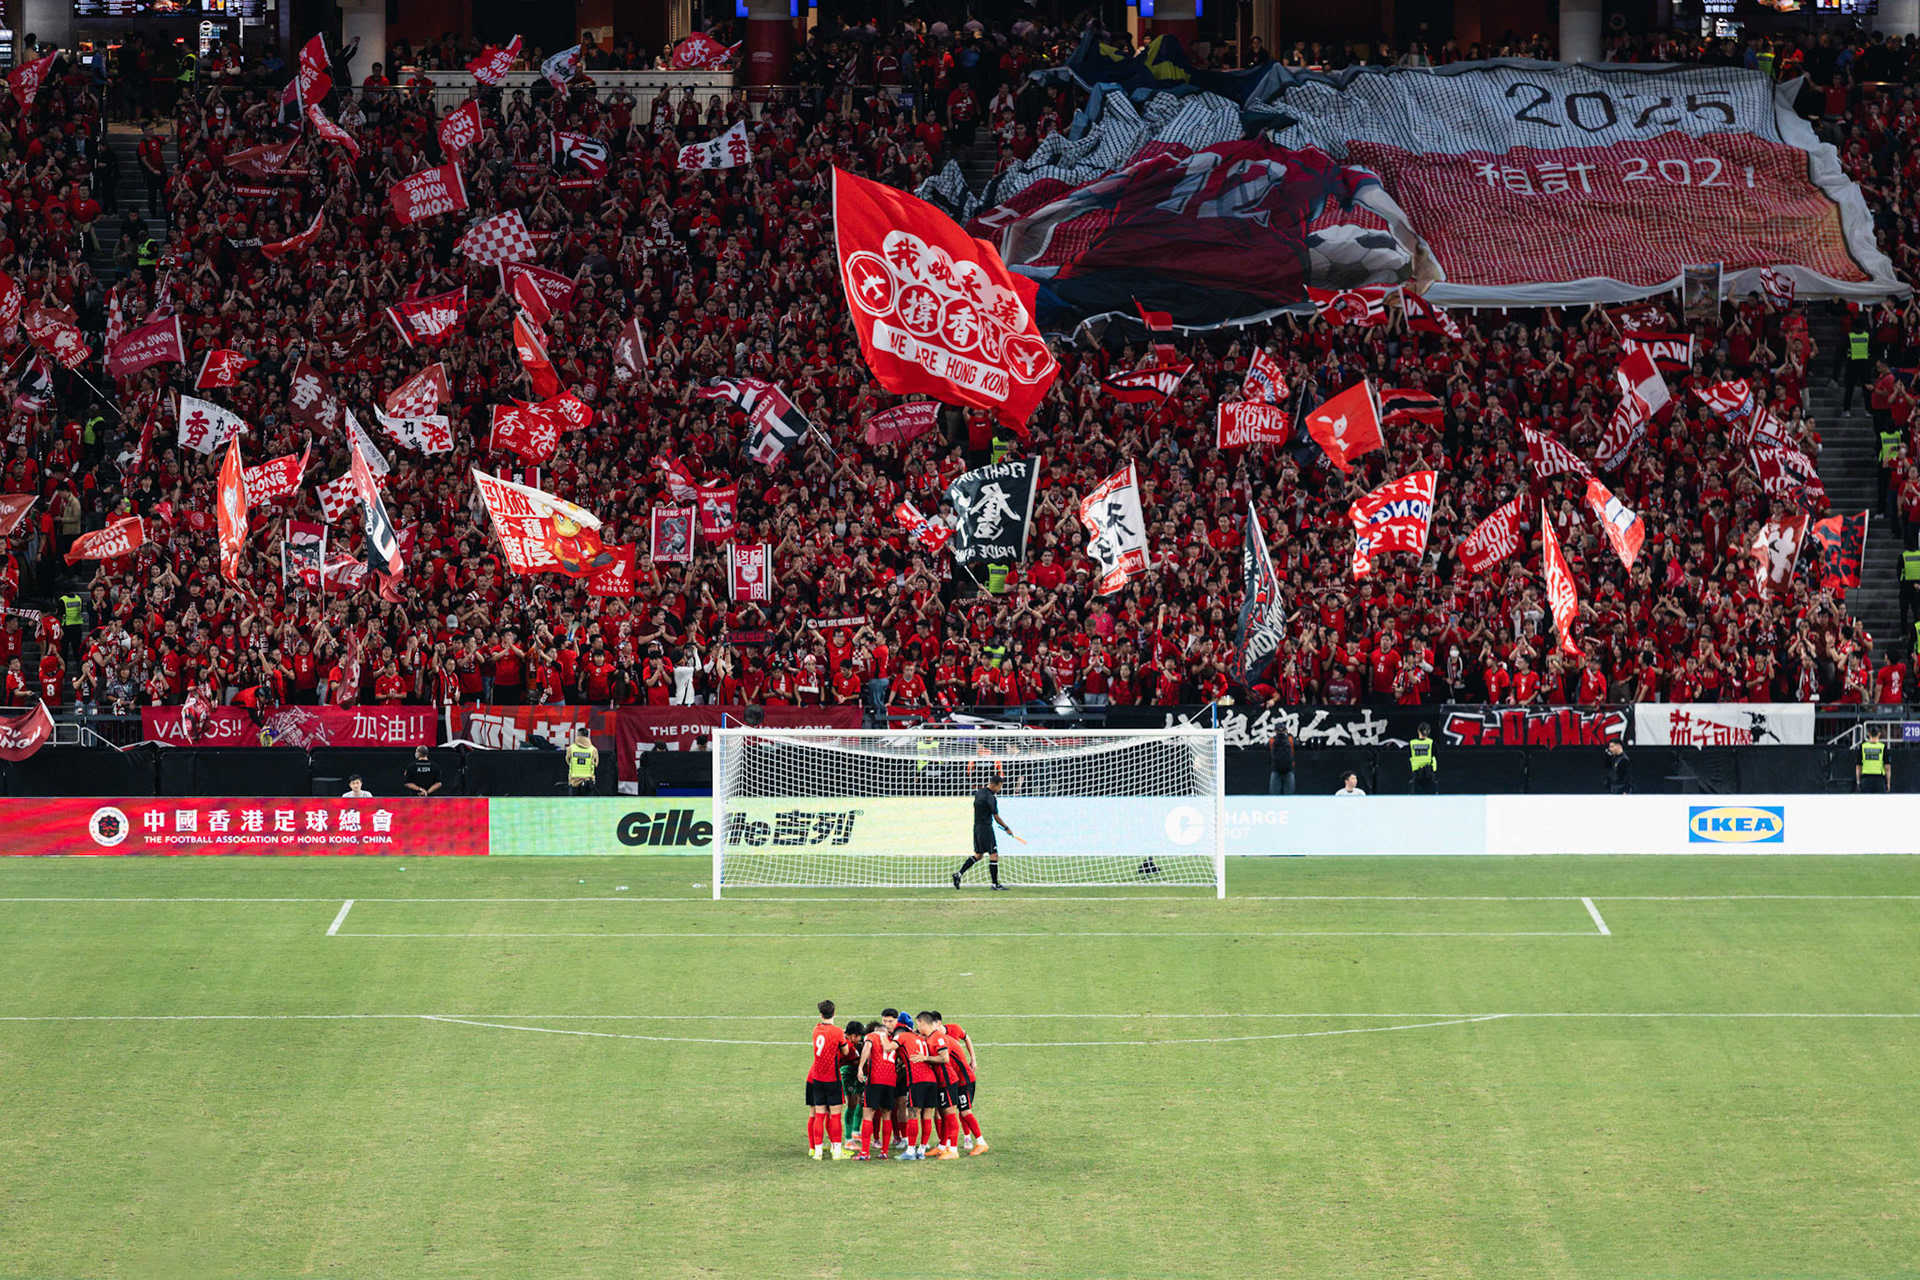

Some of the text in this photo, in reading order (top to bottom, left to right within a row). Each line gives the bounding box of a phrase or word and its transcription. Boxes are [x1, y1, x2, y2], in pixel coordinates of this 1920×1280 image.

[900, 97, 913, 106] 218
[902, 289, 1000, 358] 撐香港
[64, 349, 89, 370] SAUDI
[887, 330, 1010, 398] WE ARE HONG KONG
[186, 411, 210, 447] 香
[1235, 412, 1283, 430] HONG
[496, 410, 557, 457] 香港
[1225, 426, 1280, 446] KONG BOYS
[244, 461, 288, 483] WE ARE
[245, 472, 288, 492] HONG
[657, 509, 679, 517] BRING
[654, 553, 690, 562] HONG KONG
[306, 573, 316, 584] 12
[47, 683, 55, 696] 8
[154, 719, 242, 738] VAOS!!
[352, 712, 424, 743] 加油!!
[650, 726, 678, 736] THE
[1905, 727, 1920, 737] 219
[143, 809, 394, 833] 中國香港足球總會
[1212, 811, 1289, 825] HARGE
[1697, 817, 1775, 832] IKEA
[144, 836, 393, 845] THE FOOTBALL ASSOCIATION OF HONG KONG, CHINA
[815, 1035, 825, 1056] 9
[939, 1092, 945, 1102] 7
[958, 1094, 967, 1104] 13
